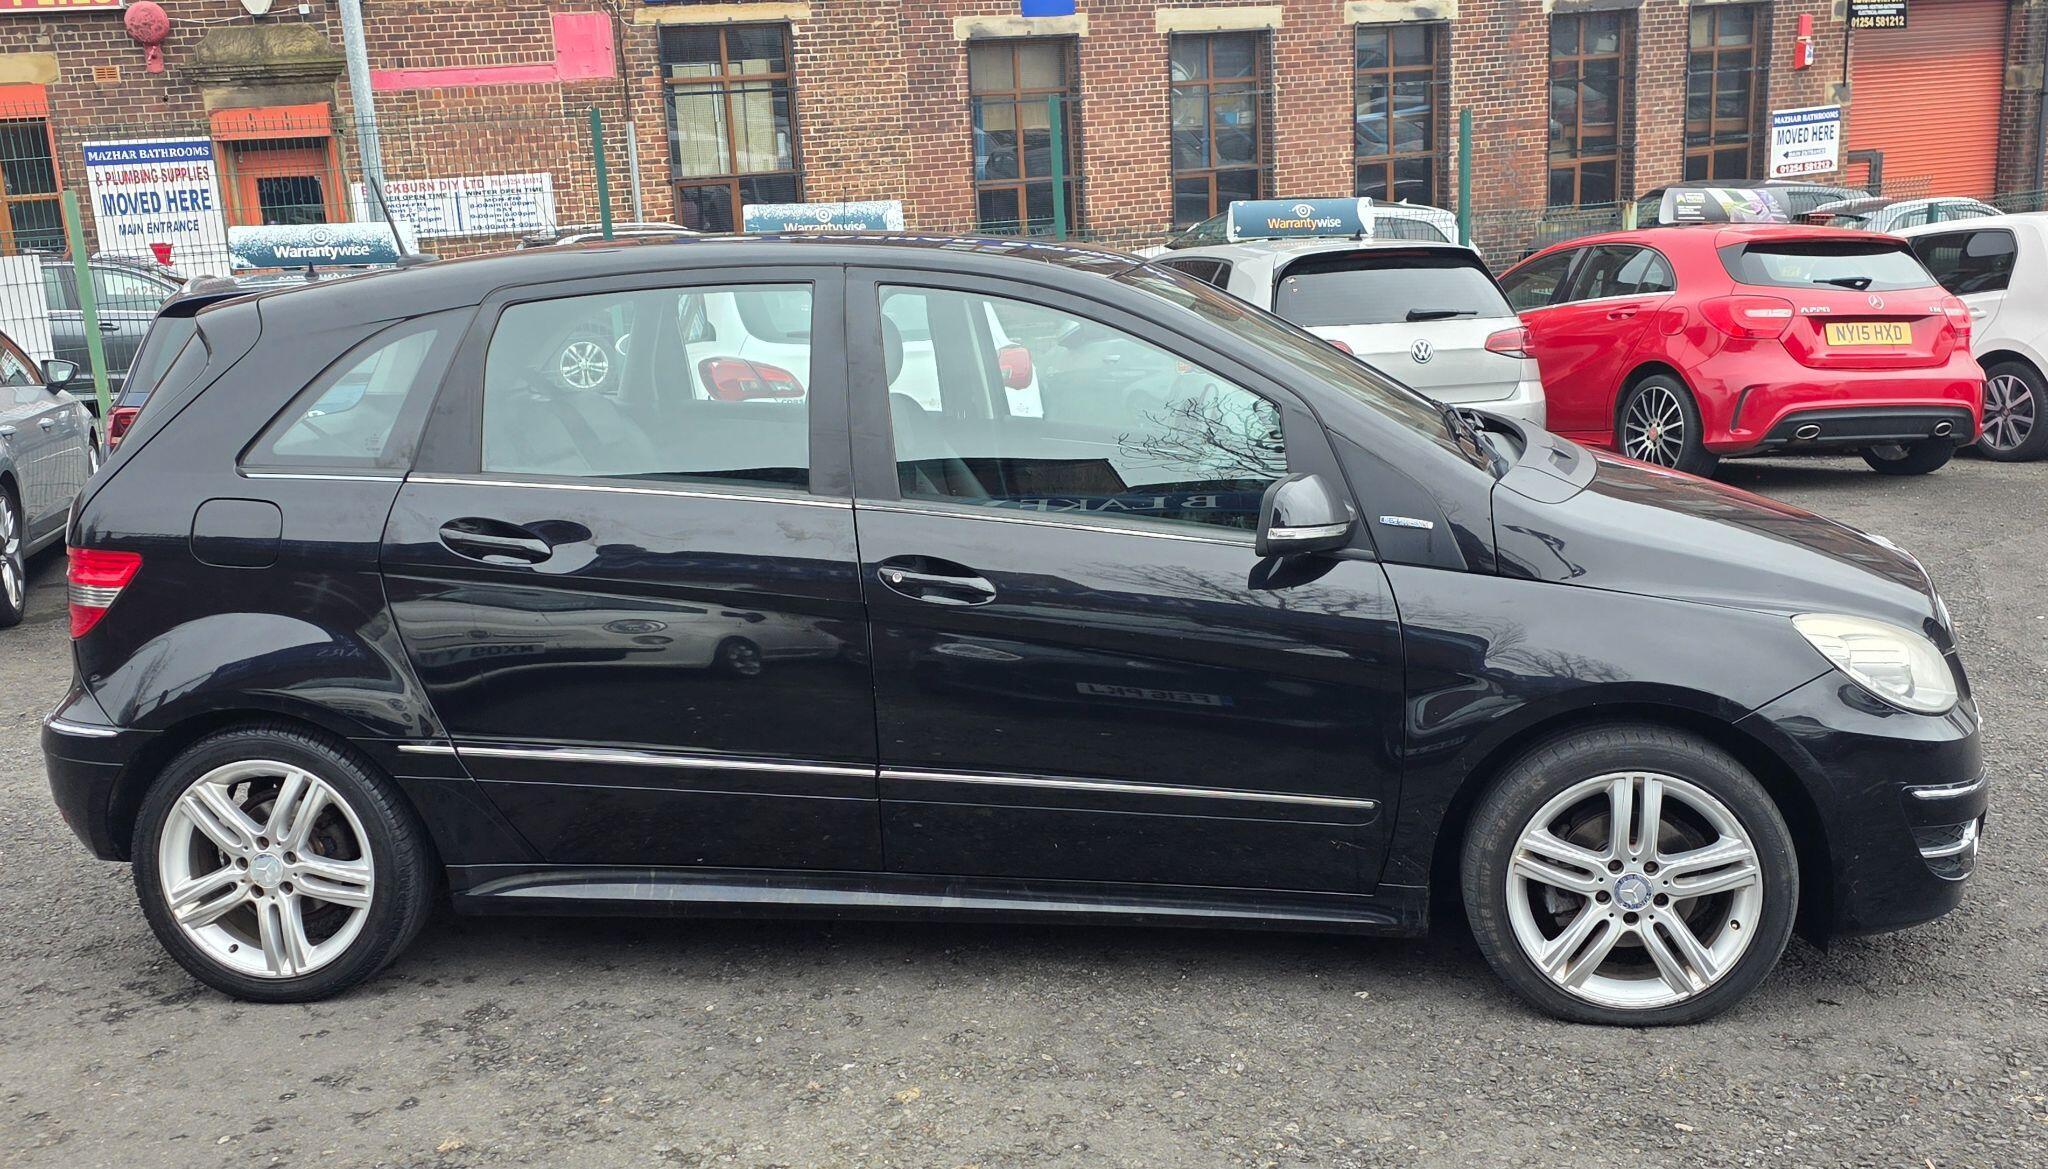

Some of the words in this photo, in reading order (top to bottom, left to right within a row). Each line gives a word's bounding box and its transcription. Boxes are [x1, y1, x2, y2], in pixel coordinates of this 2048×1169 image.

[1851, 17, 1874, 27] 01254
[1875, 16, 1905, 27] 581212
[1776, 127, 1809, 146] MOVED
[1812, 125, 1835, 142] HERE
[88, 149, 137, 161] MAZHAR
[139, 146, 209, 159] BATHROOMS
[96, 172, 103, 187] &
[106, 168, 159, 186] PLUMBING
[161, 166, 210, 183] SUPPLIES
[440, 180, 459, 190] DIY
[463, 179, 484, 189] LTD
[101, 191, 162, 216] MOVED
[166, 188, 212, 212] HERE
[118, 223, 144, 236] MAIN
[147, 219, 200, 234] ENTRANCE
[783, 219, 867, 231] Warrantywise
[1267, 216, 1342, 231] Warrantywise
[273, 244, 370, 260] Warrantywise
[1836, 324, 1870, 342] NY15
[1875, 324, 1903, 341] HXD
